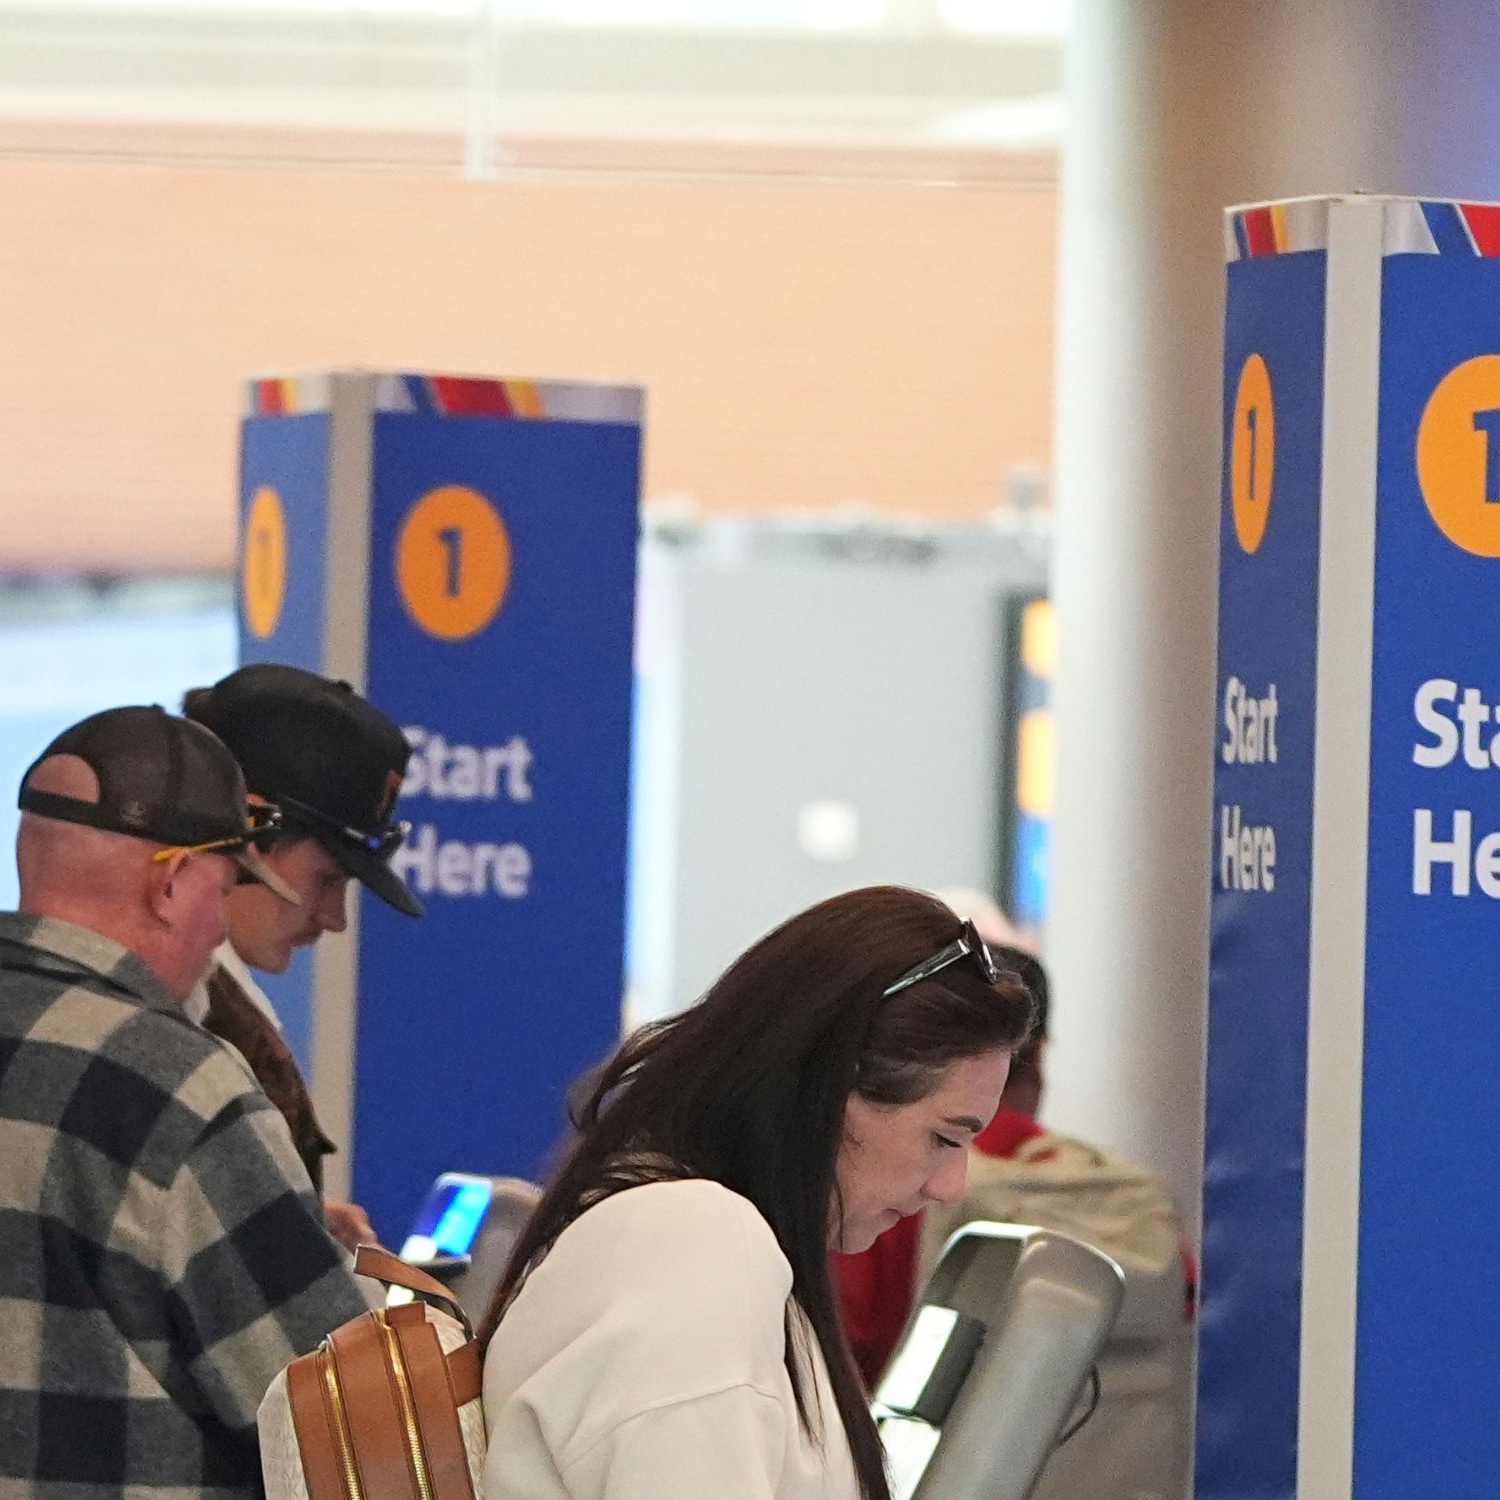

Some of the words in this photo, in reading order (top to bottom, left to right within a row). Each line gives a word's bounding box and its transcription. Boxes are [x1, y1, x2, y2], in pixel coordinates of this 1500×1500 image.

[1471, 408, 1500, 505] 1
[436, 527, 464, 599] 1
[1222, 676, 1279, 766] Start
[1411, 678, 1500, 769] St
[387, 824, 533, 901] Here
[1220, 803, 1277, 892] Here
